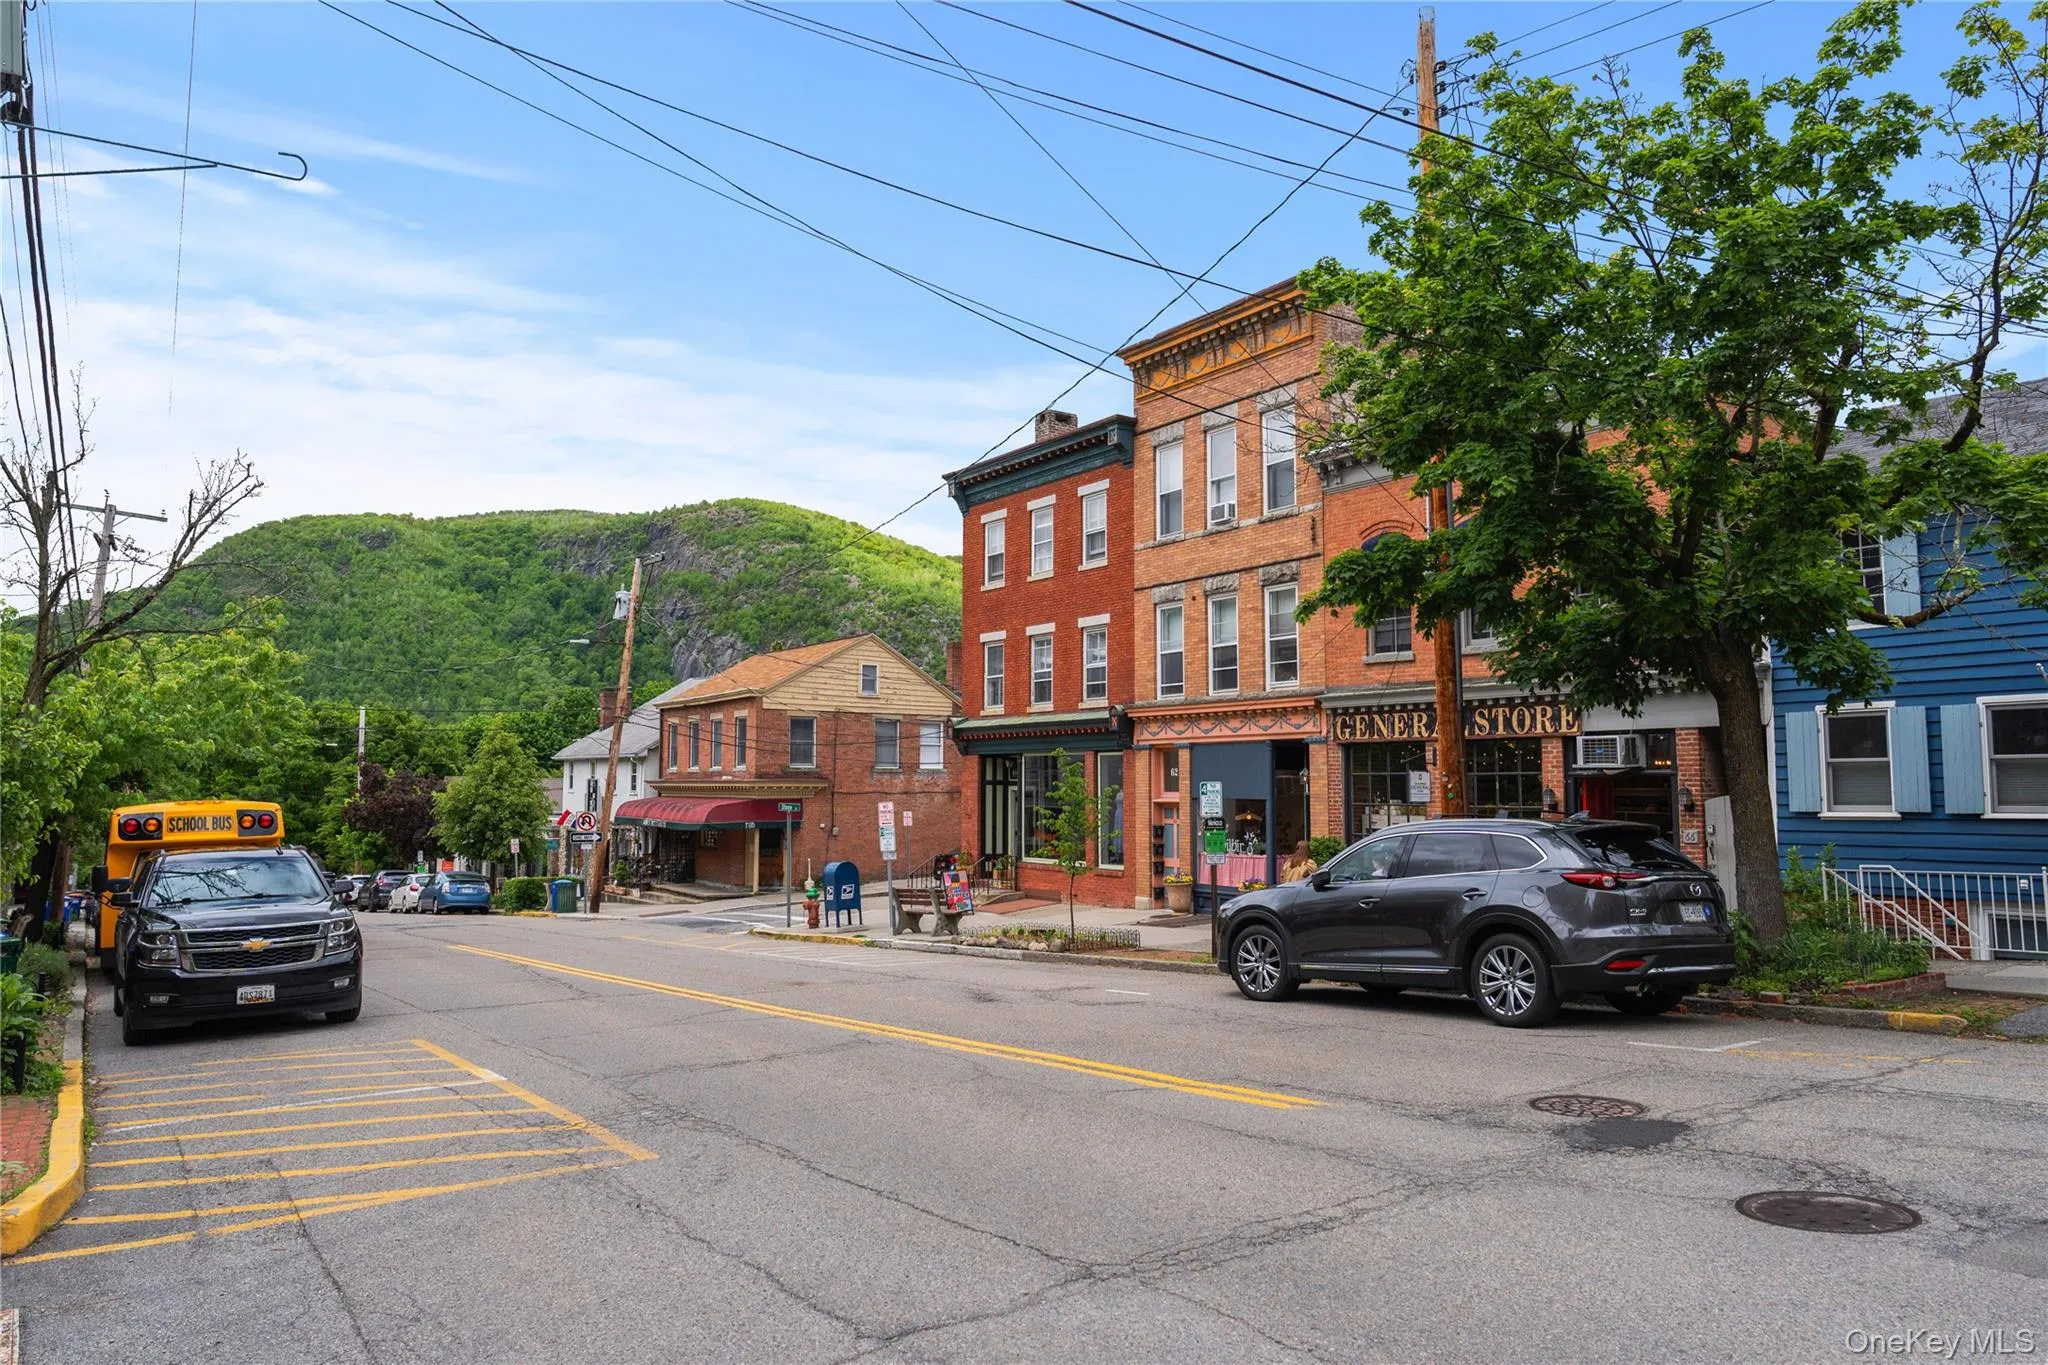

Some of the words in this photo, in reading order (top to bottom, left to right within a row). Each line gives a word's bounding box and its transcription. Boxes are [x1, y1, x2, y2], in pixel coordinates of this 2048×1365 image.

[1335, 711, 1469, 740] GENER
[1474, 704, 1580, 736] STORE
[1170, 767, 1178, 776] 62
[168, 816, 209, 832] SCHOOL
[212, 816, 232, 831] BUS
